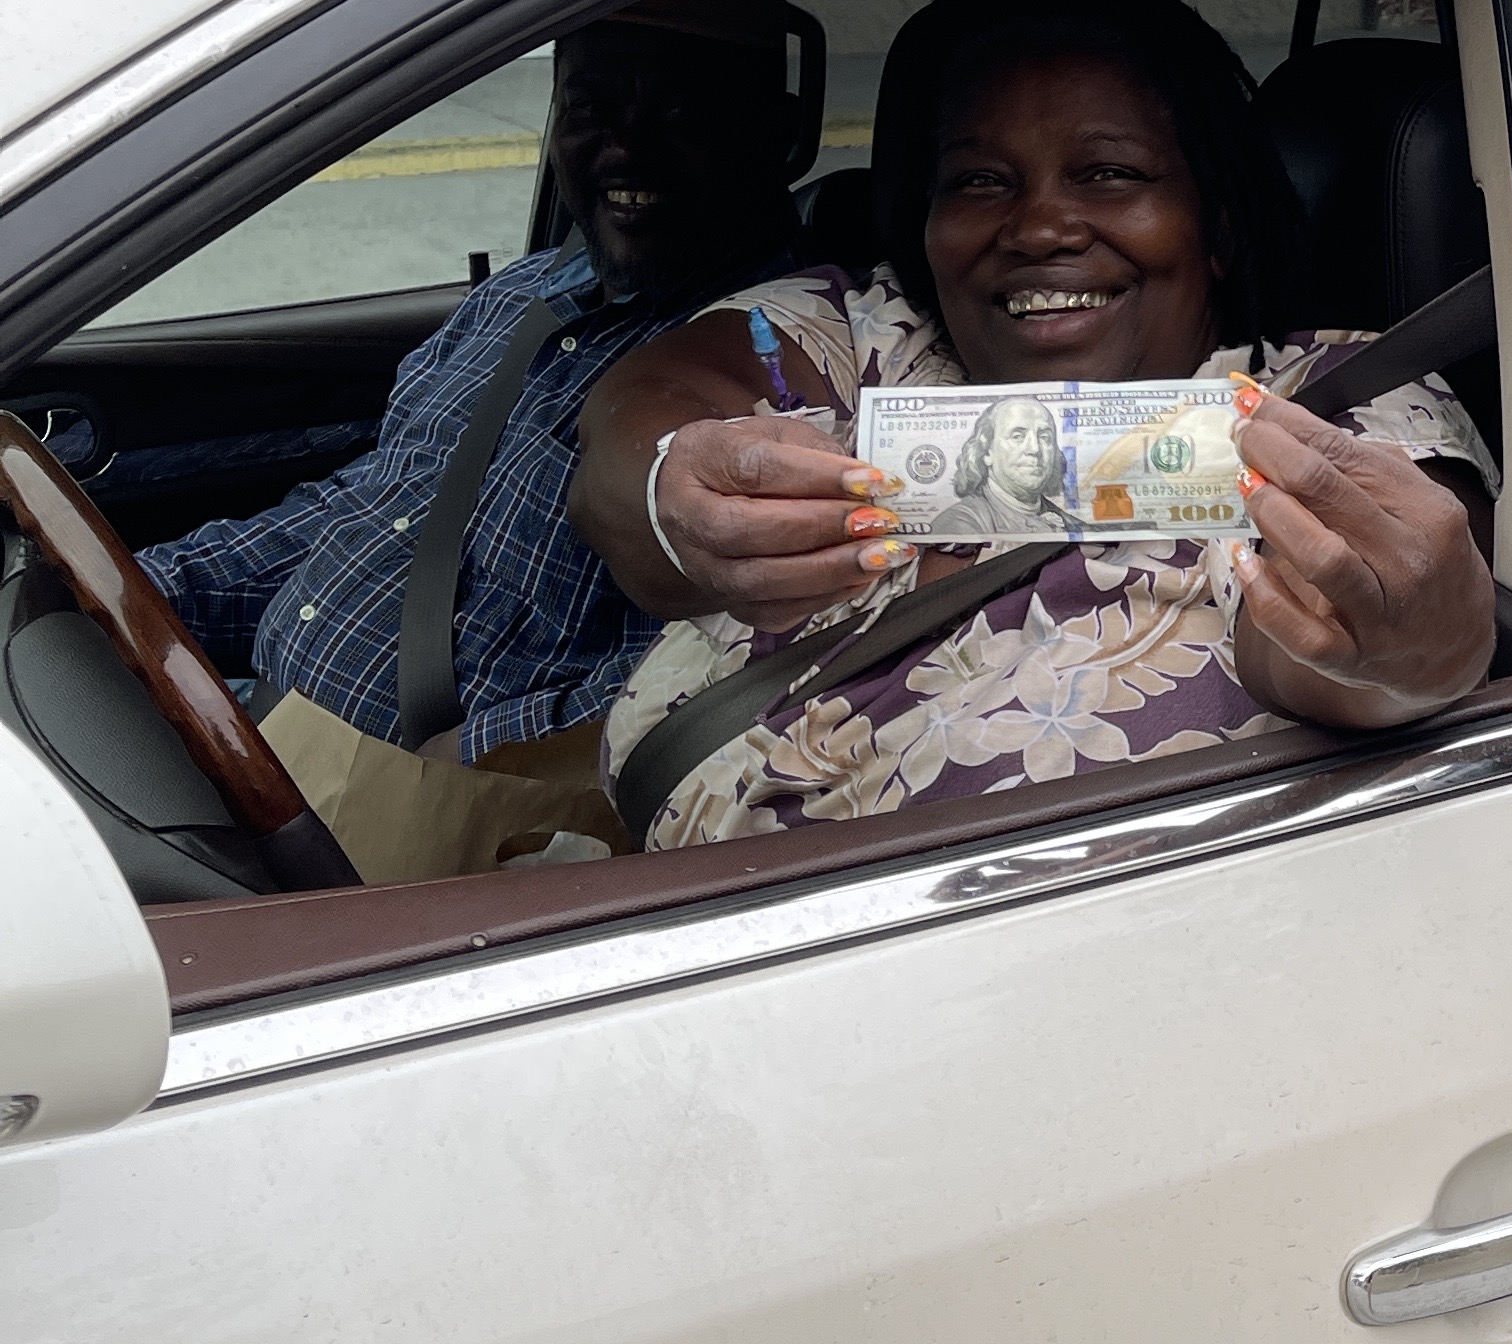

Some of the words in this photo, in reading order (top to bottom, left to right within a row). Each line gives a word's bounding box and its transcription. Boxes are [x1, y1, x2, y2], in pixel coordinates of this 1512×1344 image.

[877, 398, 926, 412] 100
[1184, 392, 1234, 406] 100
[1169, 504, 1235, 522] 100
